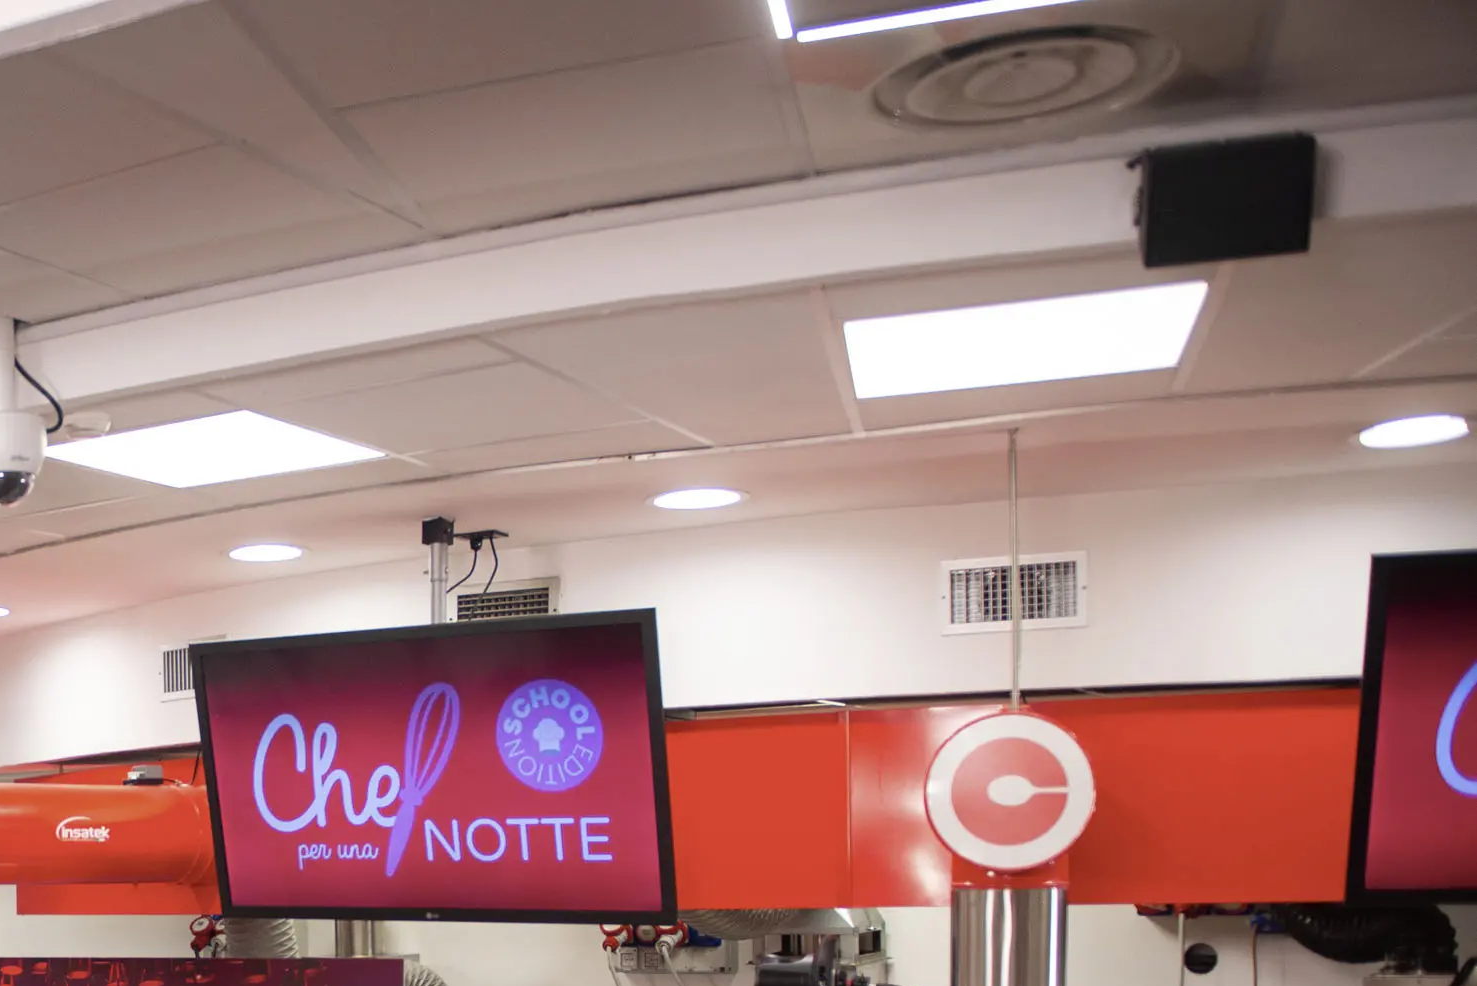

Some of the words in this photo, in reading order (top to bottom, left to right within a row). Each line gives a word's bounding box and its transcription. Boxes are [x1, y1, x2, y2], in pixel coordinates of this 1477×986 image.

[503, 686, 596, 741] SCHOOL
[253, 682, 460, 877] Chef
[504, 738, 594, 785] EDITION
[61, 825, 111, 841] insatek
[297, 841, 332, 870] per
[337, 842, 379, 860] una
[424, 816, 613, 861] NOTTE
